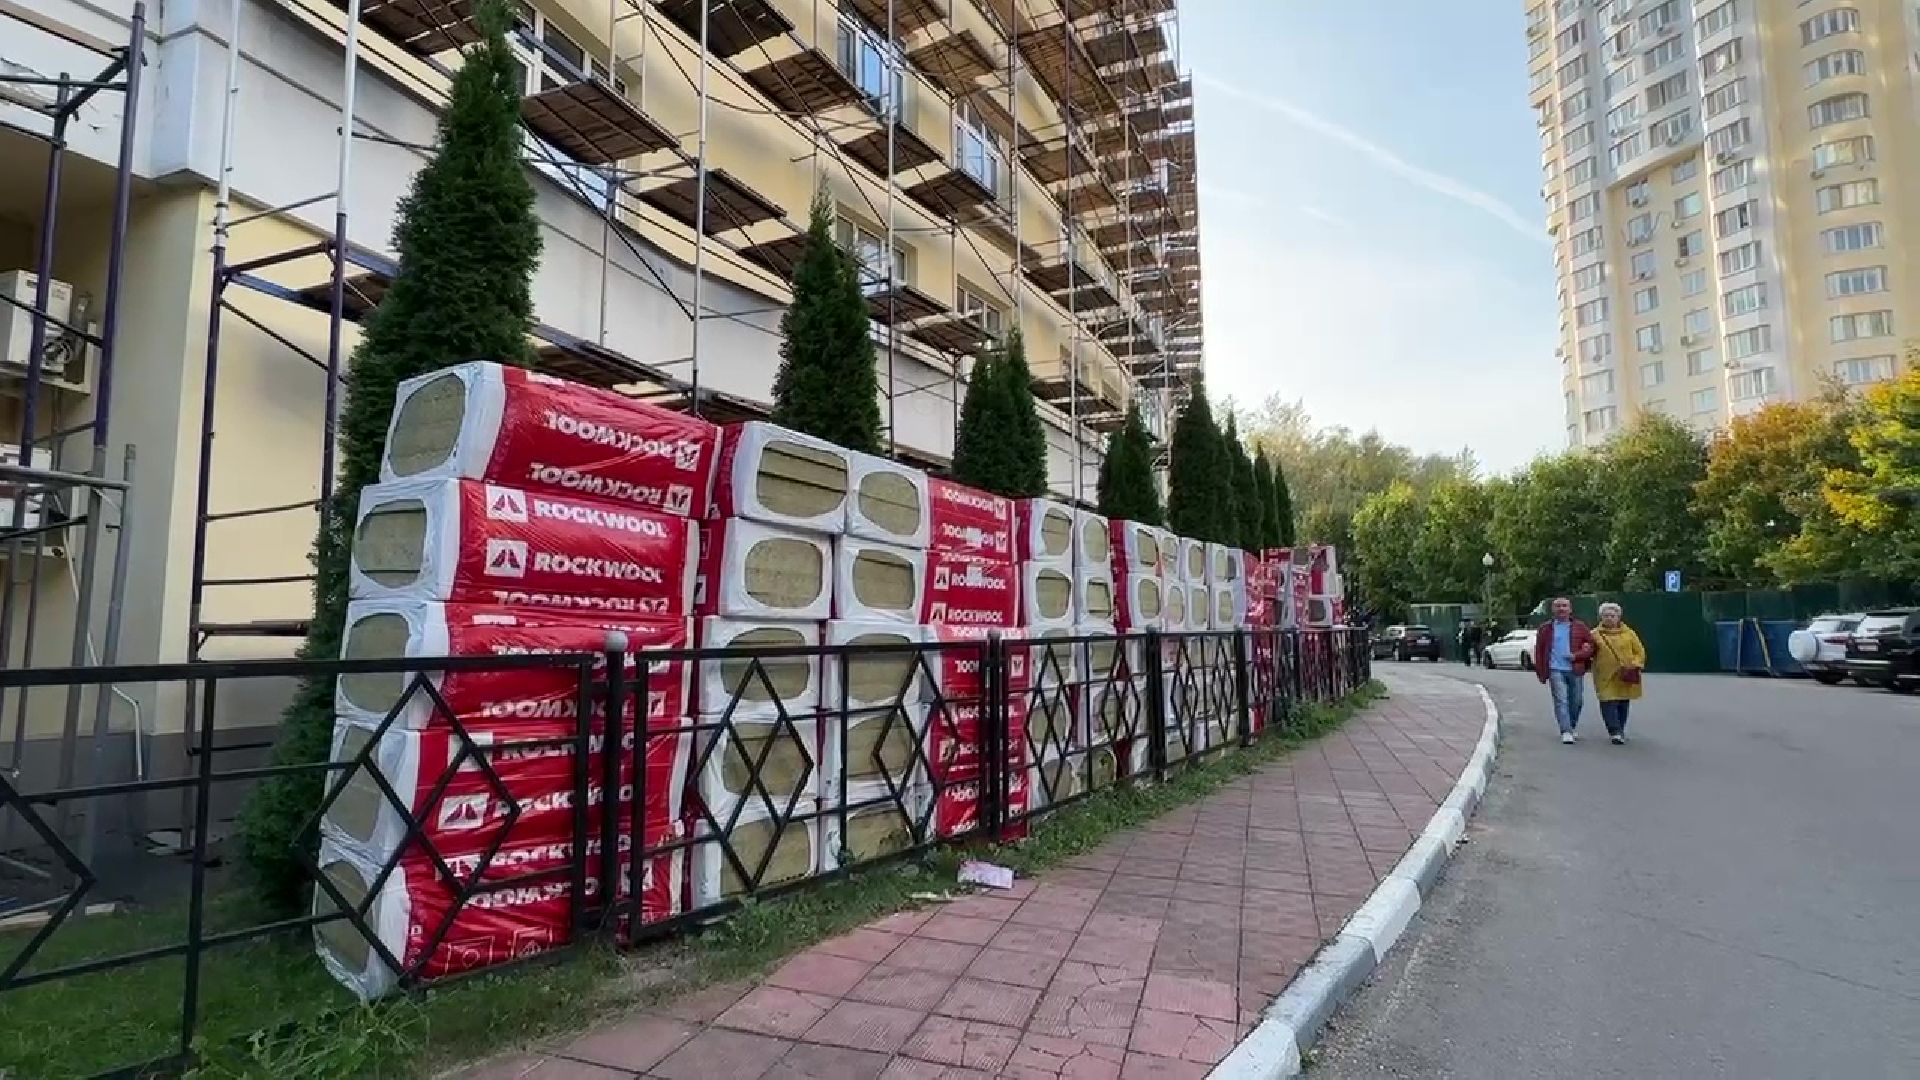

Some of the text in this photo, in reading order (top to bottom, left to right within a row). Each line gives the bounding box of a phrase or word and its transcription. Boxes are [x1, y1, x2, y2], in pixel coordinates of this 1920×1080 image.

[543, 409, 675, 458] ROCKWOOL
[528, 463, 662, 504] ROCKWOOL
[534, 499, 667, 538] ROCKWOOL
[534, 552, 662, 583] ROCKWOOL
